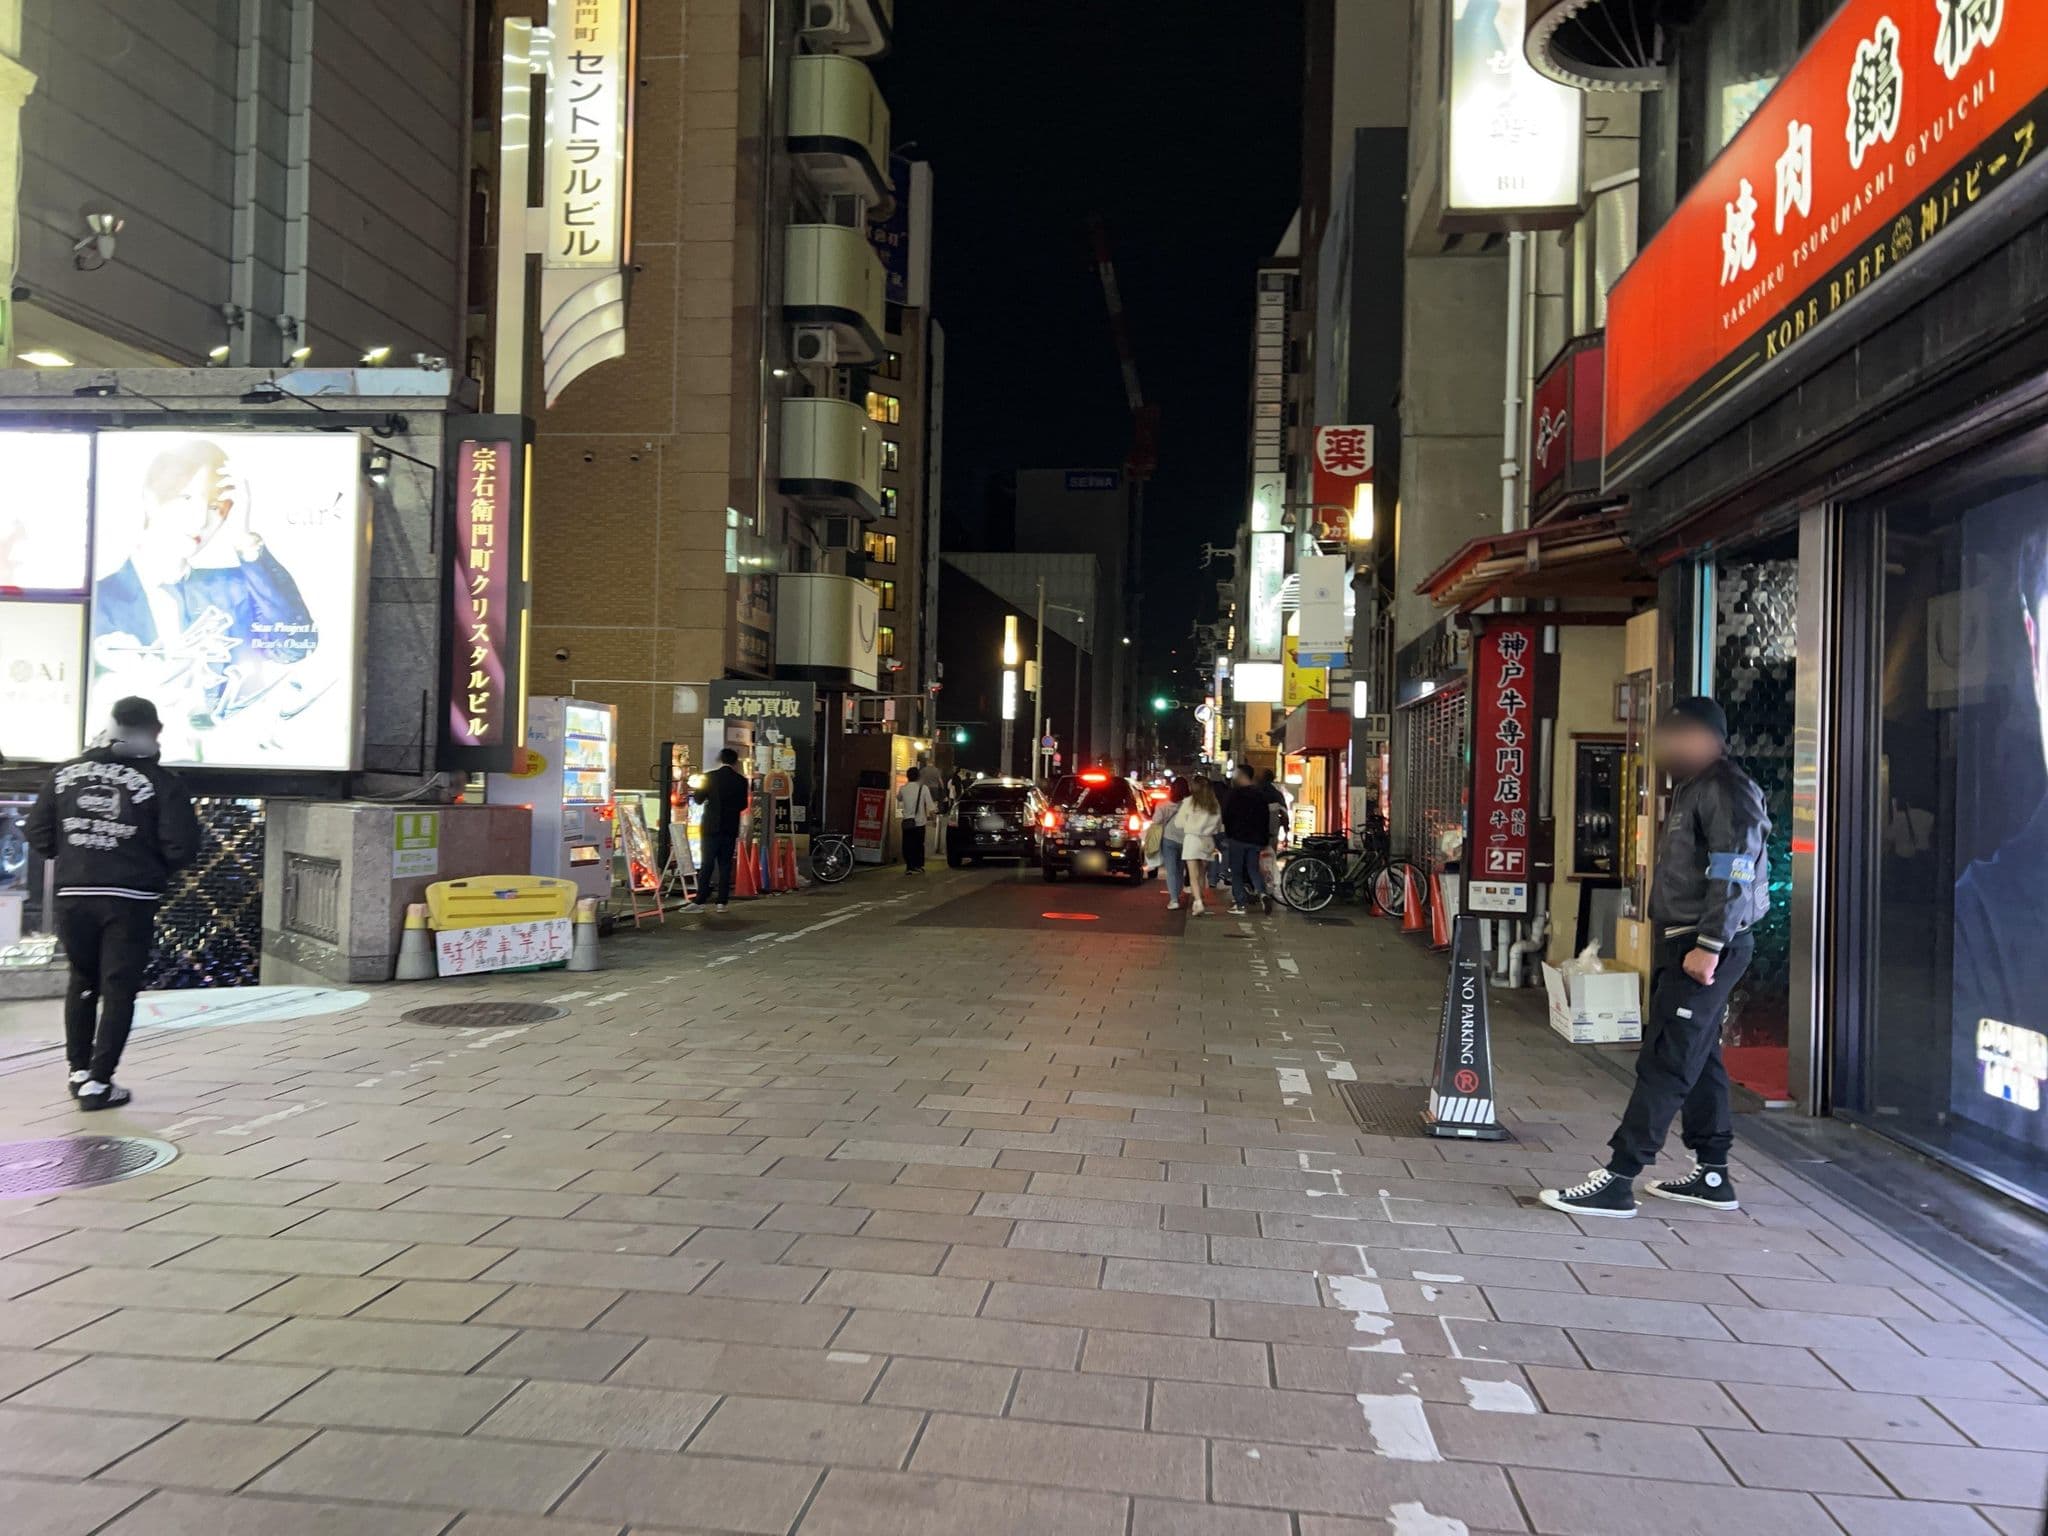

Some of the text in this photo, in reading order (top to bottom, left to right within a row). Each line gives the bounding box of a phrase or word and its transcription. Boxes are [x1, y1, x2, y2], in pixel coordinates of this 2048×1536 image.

[562, 0, 604, 256] 門町 セントラルビル
[1720, 119, 1813, 287] 焼肉
[1722, 68, 1995, 330] YAKINIKU TSURUHASHI GYUICHI
[1766, 297, 1818, 360] KOBE
[1830, 243, 1886, 313] BEEF
[1325, 428, 1366, 471] 薬
[467, 447, 496, 737] 宗右衛門町クリスタルビル
[274, 622, 310, 635] Project
[286, 637, 317, 650] Osaka
[723, 697, 800, 718] 高価買取
[1494, 631, 1528, 803] 神戸牛専門店
[1490, 808, 1509, 842] 牛一
[1489, 850, 1523, 871] 2F
[1461, 976, 1475, 1000] NO
[1460, 1003, 1475, 1065] PARKING
